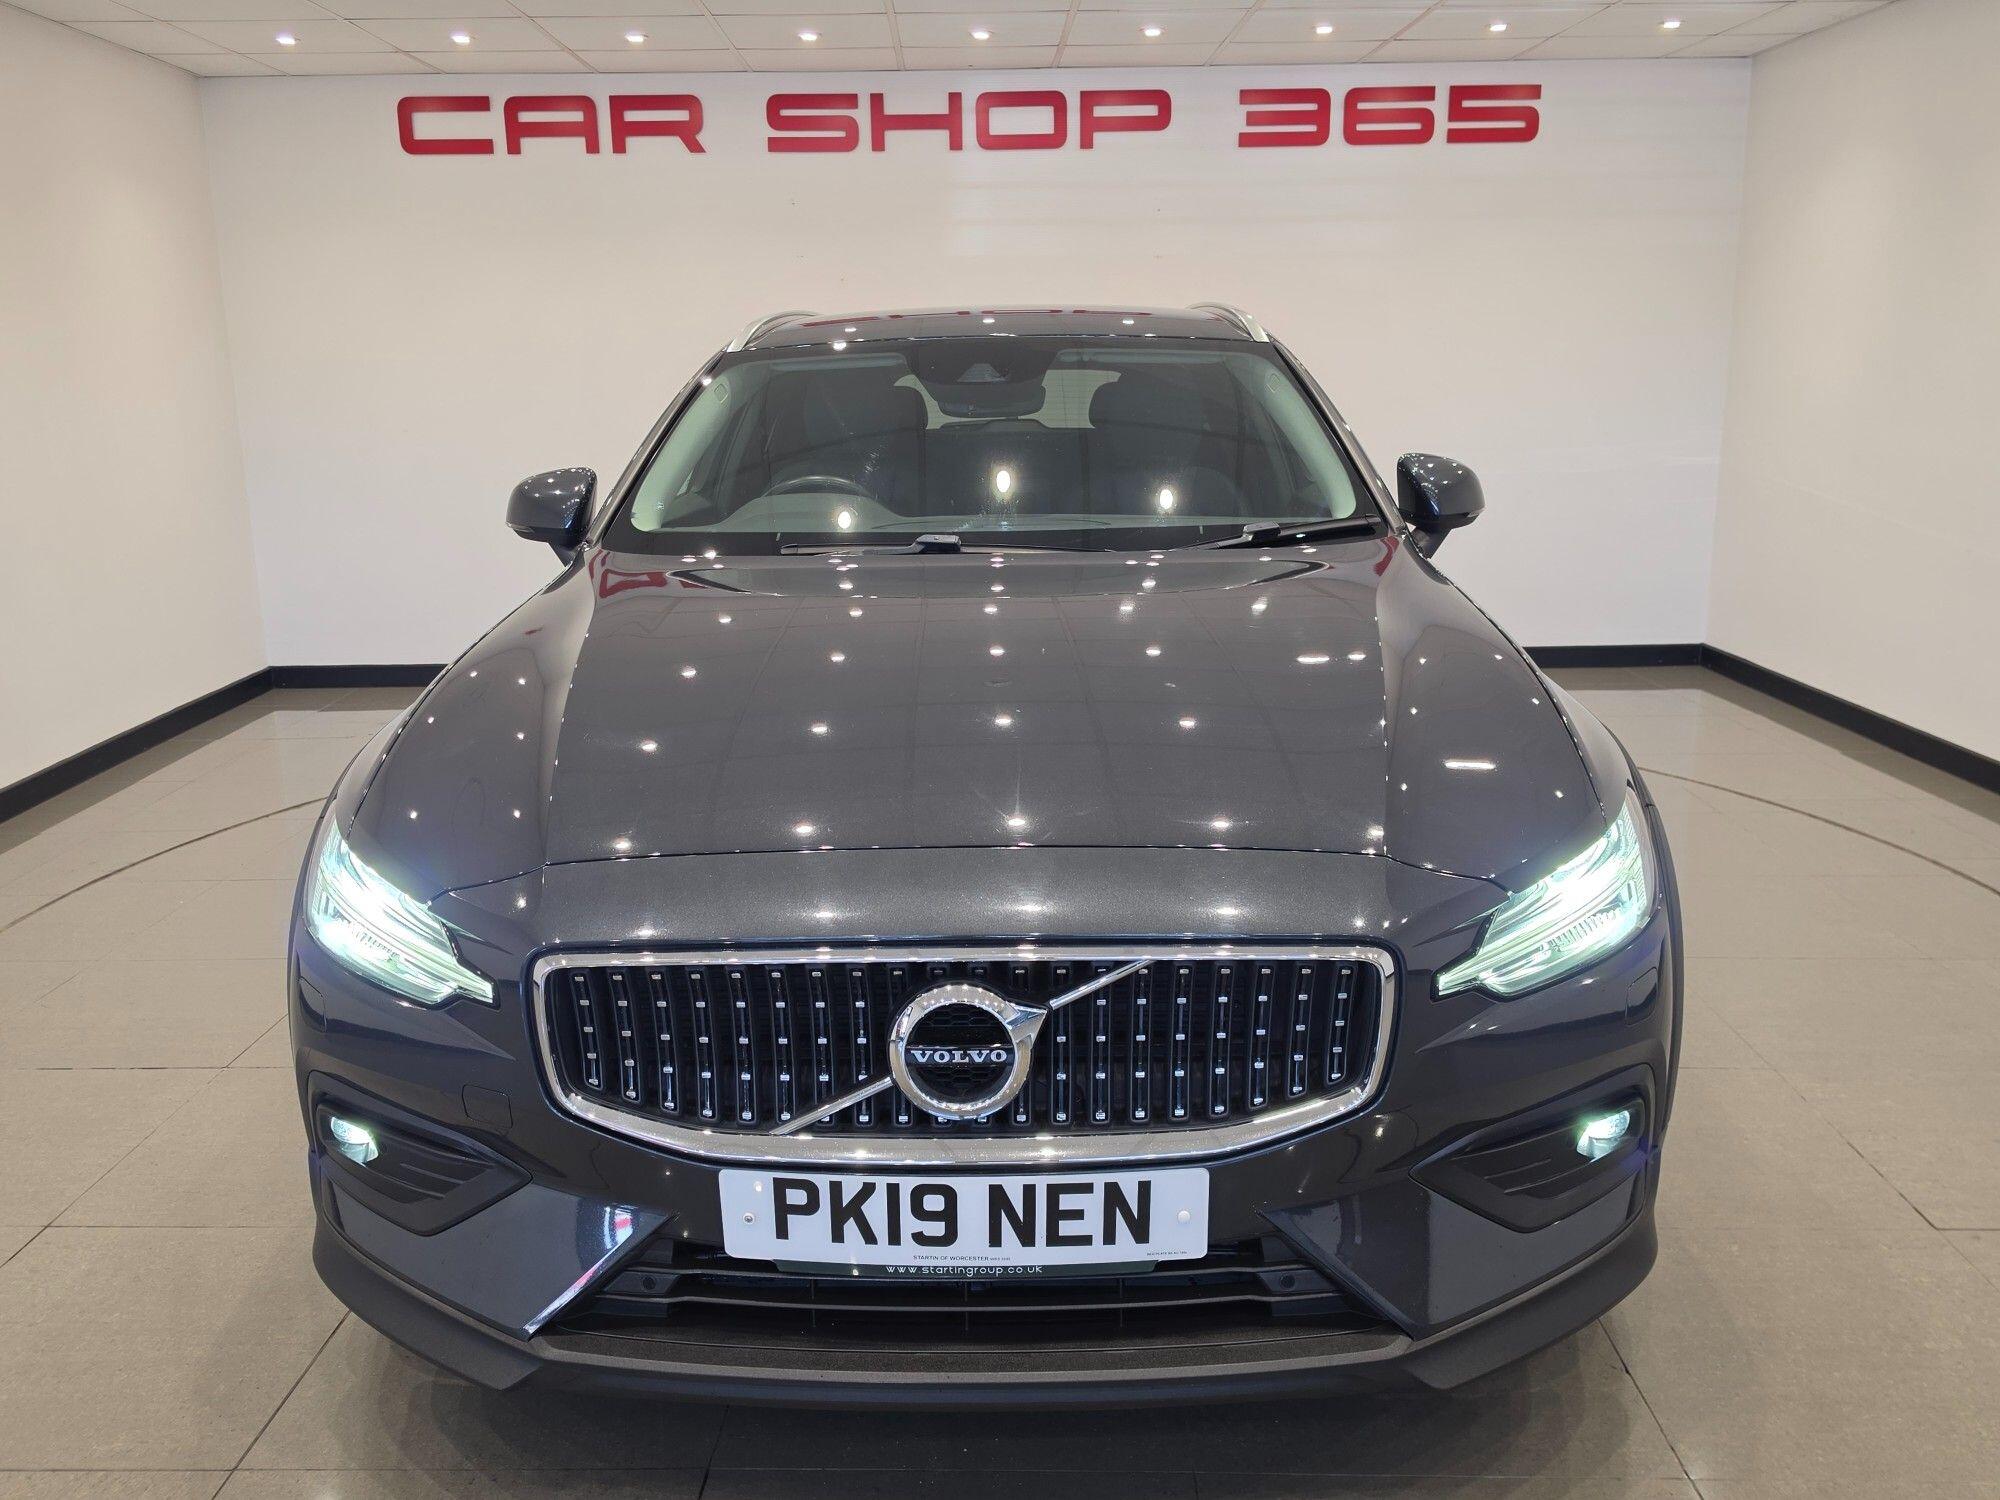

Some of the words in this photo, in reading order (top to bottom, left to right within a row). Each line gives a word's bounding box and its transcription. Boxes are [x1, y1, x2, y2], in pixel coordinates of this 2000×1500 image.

[397, 95, 705, 155] CAR
[766, 90, 1172, 152] SHOP
[1238, 85, 1542, 147] 365
[911, 1049, 1008, 1063] VOLVO
[772, 1176, 960, 1248] PK19
[987, 1179, 1152, 1248] NEN
[885, 1264, 1043, 1277] www.startingroup.co.uk
